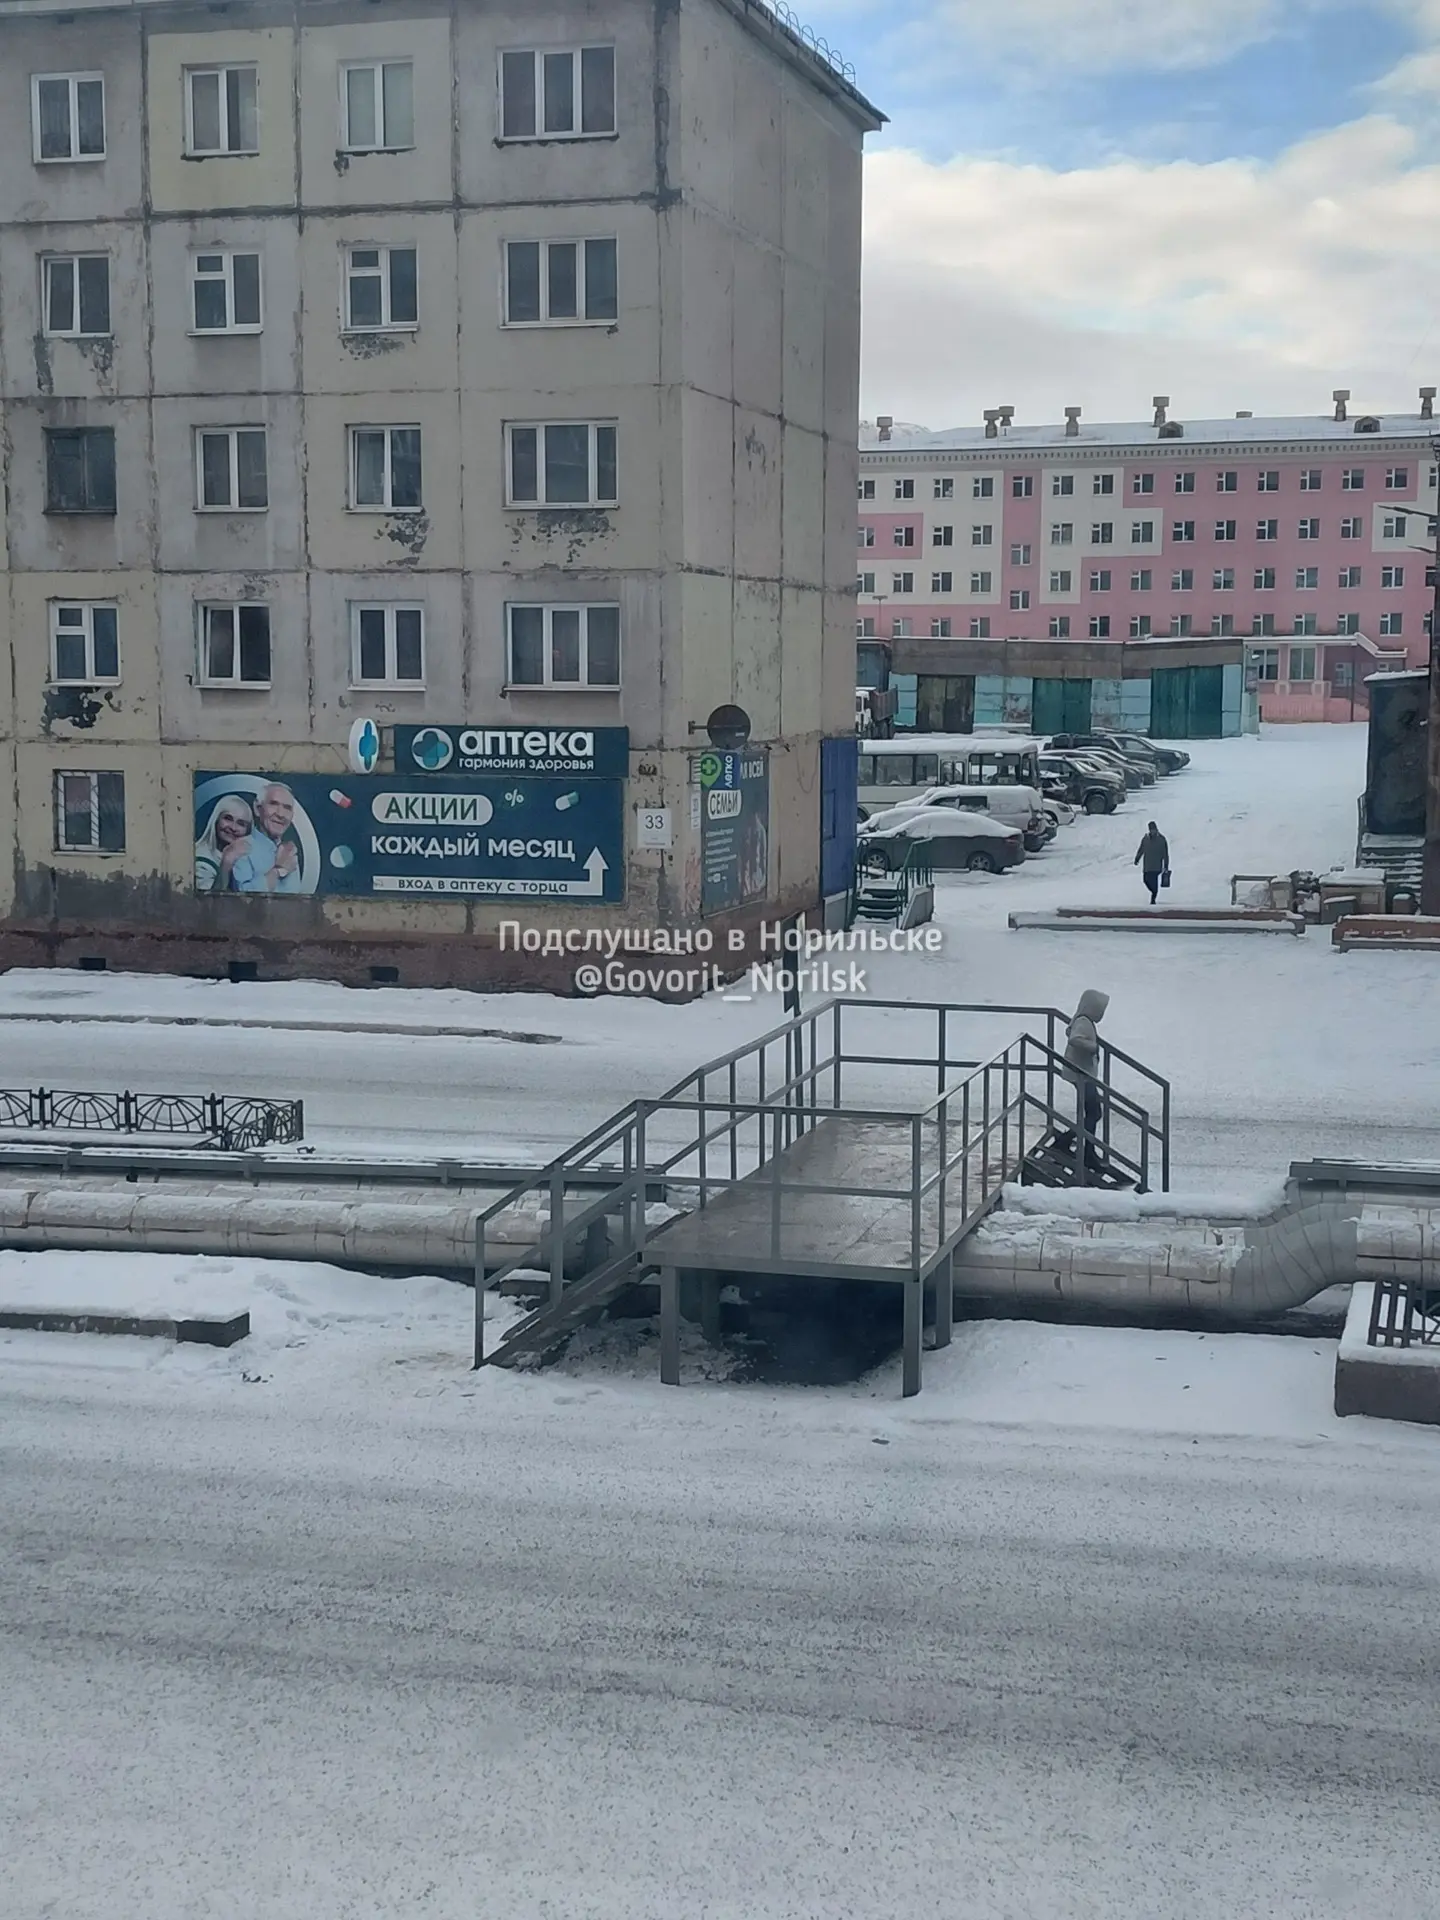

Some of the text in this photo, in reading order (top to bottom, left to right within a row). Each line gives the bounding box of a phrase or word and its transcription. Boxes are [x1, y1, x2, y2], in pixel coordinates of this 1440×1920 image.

[458, 730, 595, 756] аптека
[458, 758, 595, 771] гармония здоровья
[384, 796, 478, 824] АКЦИИ
[709, 791, 739, 816] СЕМЬИ
[645, 815, 664, 829] 33
[371, 832, 576, 862] каждый месяц
[398, 878, 569, 894] вход в аптеку с торца
